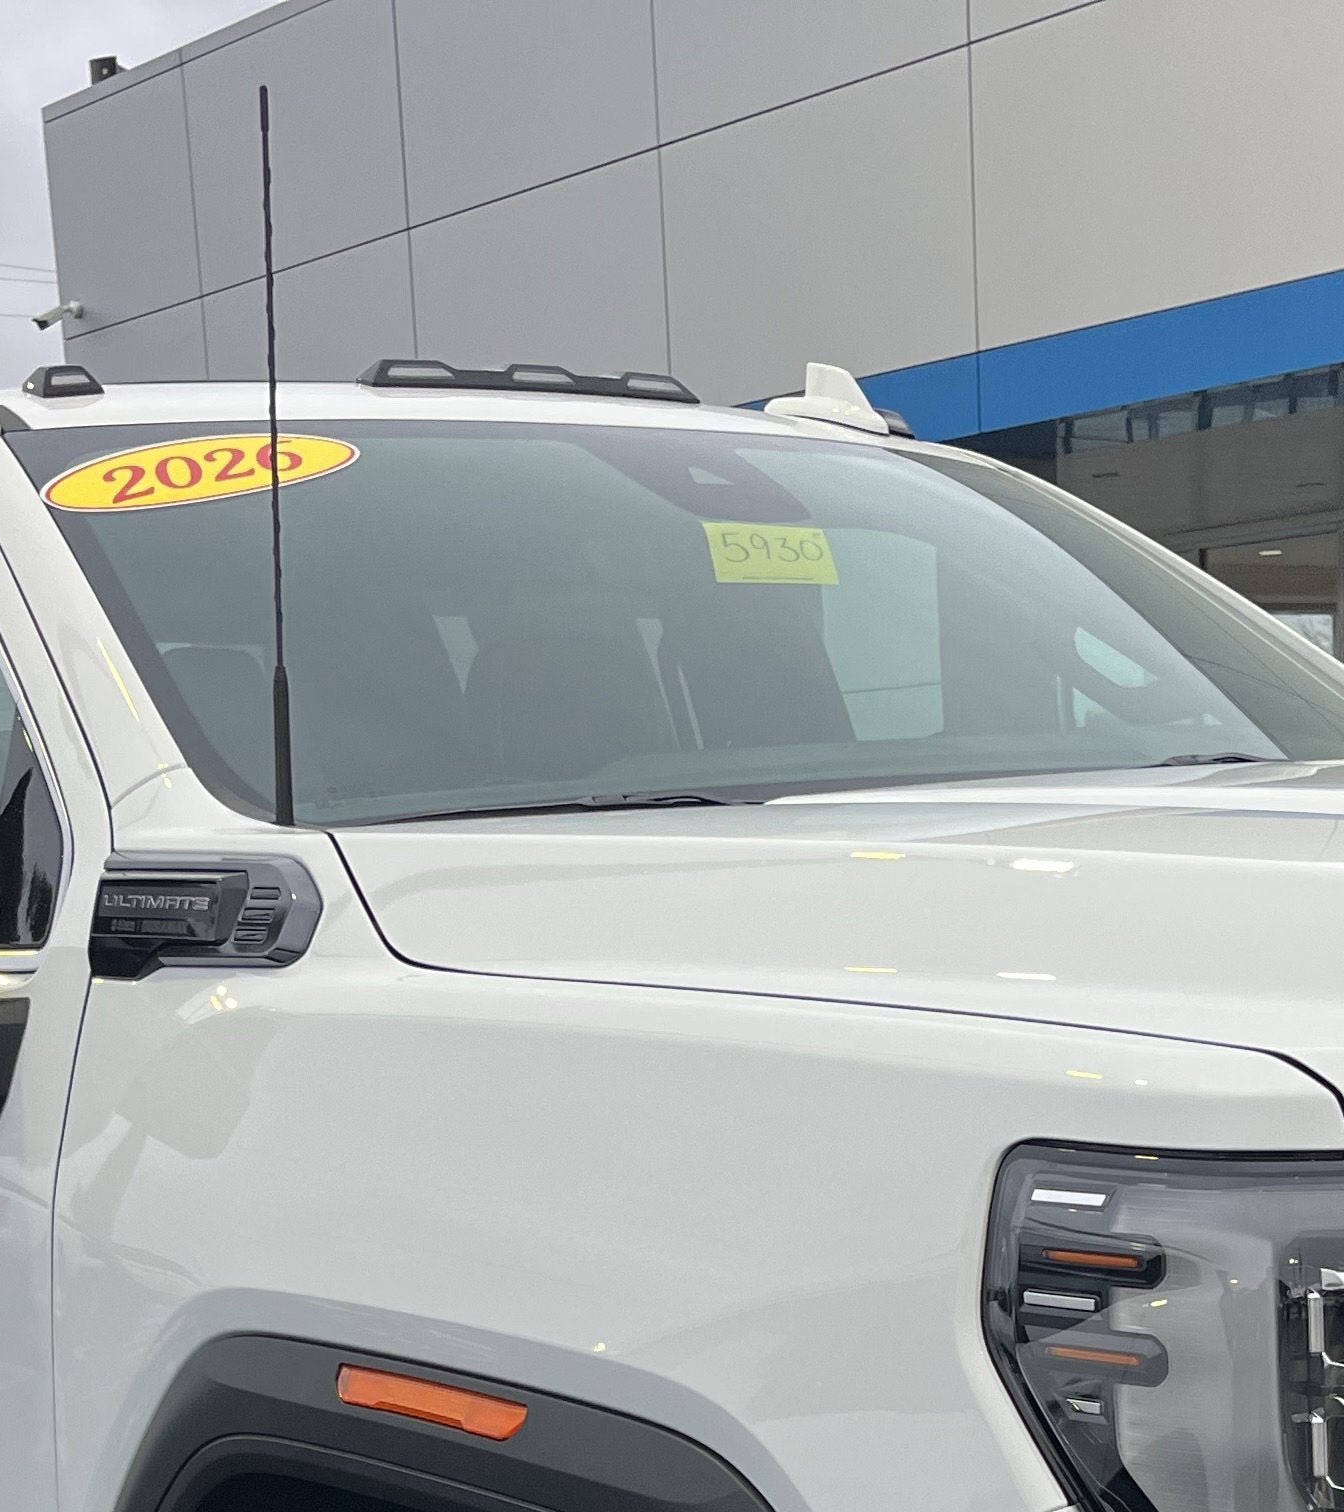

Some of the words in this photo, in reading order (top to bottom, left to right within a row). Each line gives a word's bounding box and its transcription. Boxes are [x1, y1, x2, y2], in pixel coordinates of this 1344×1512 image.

[102, 439, 304, 504] 2026
[720, 532, 824, 563] 5930
[103, 893, 211, 912] ULTIMATE
